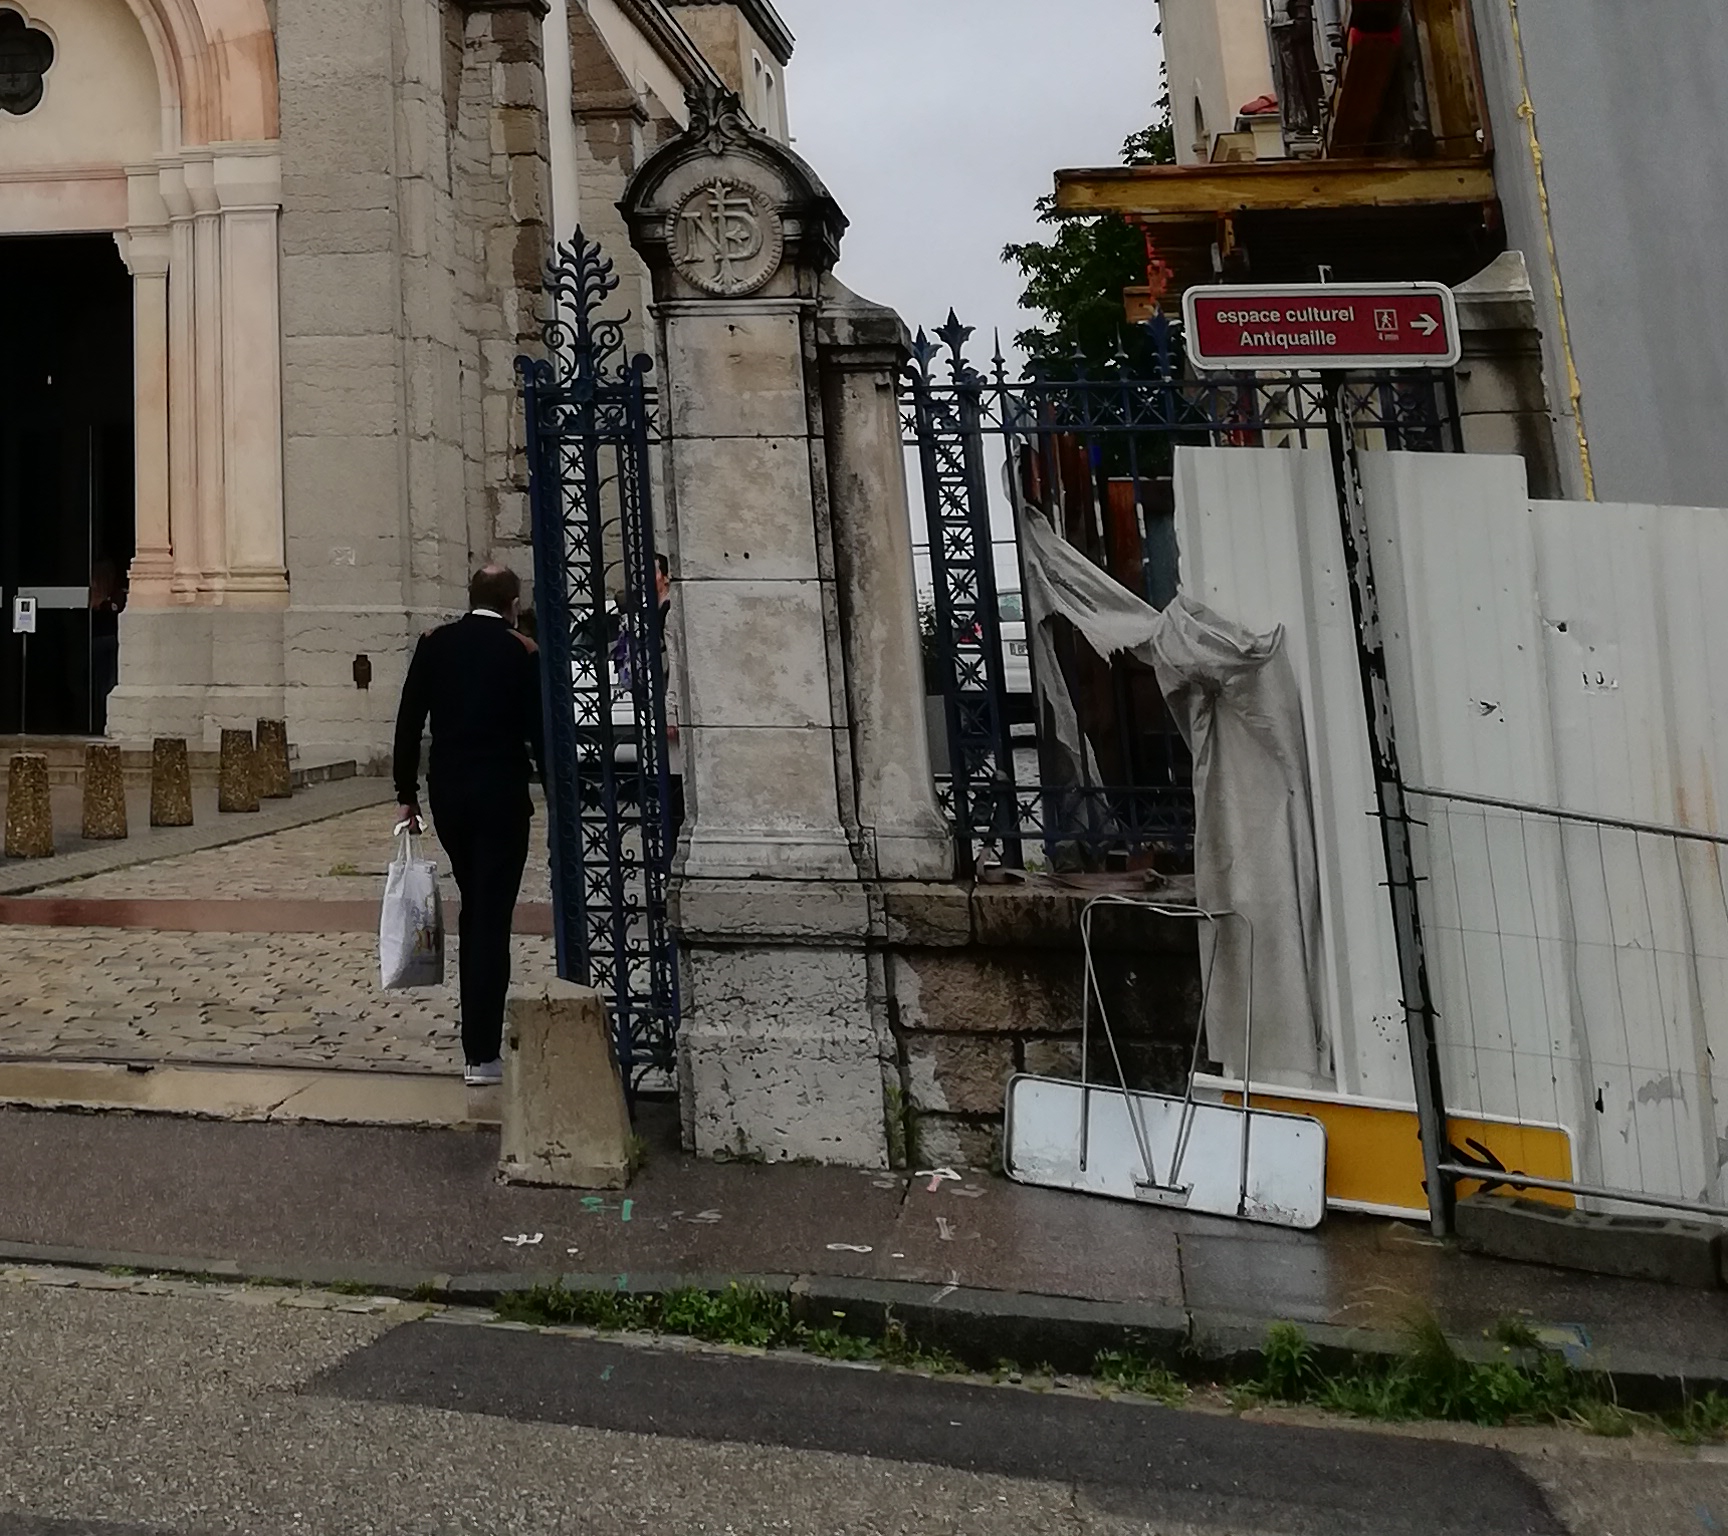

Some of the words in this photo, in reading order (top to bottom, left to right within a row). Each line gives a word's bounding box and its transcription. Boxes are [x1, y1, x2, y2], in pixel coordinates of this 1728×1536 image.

[1216, 309, 1281, 325] espace
[1285, 306, 1355, 323] culturel
[1240, 330, 1337, 349] Antiquaille
